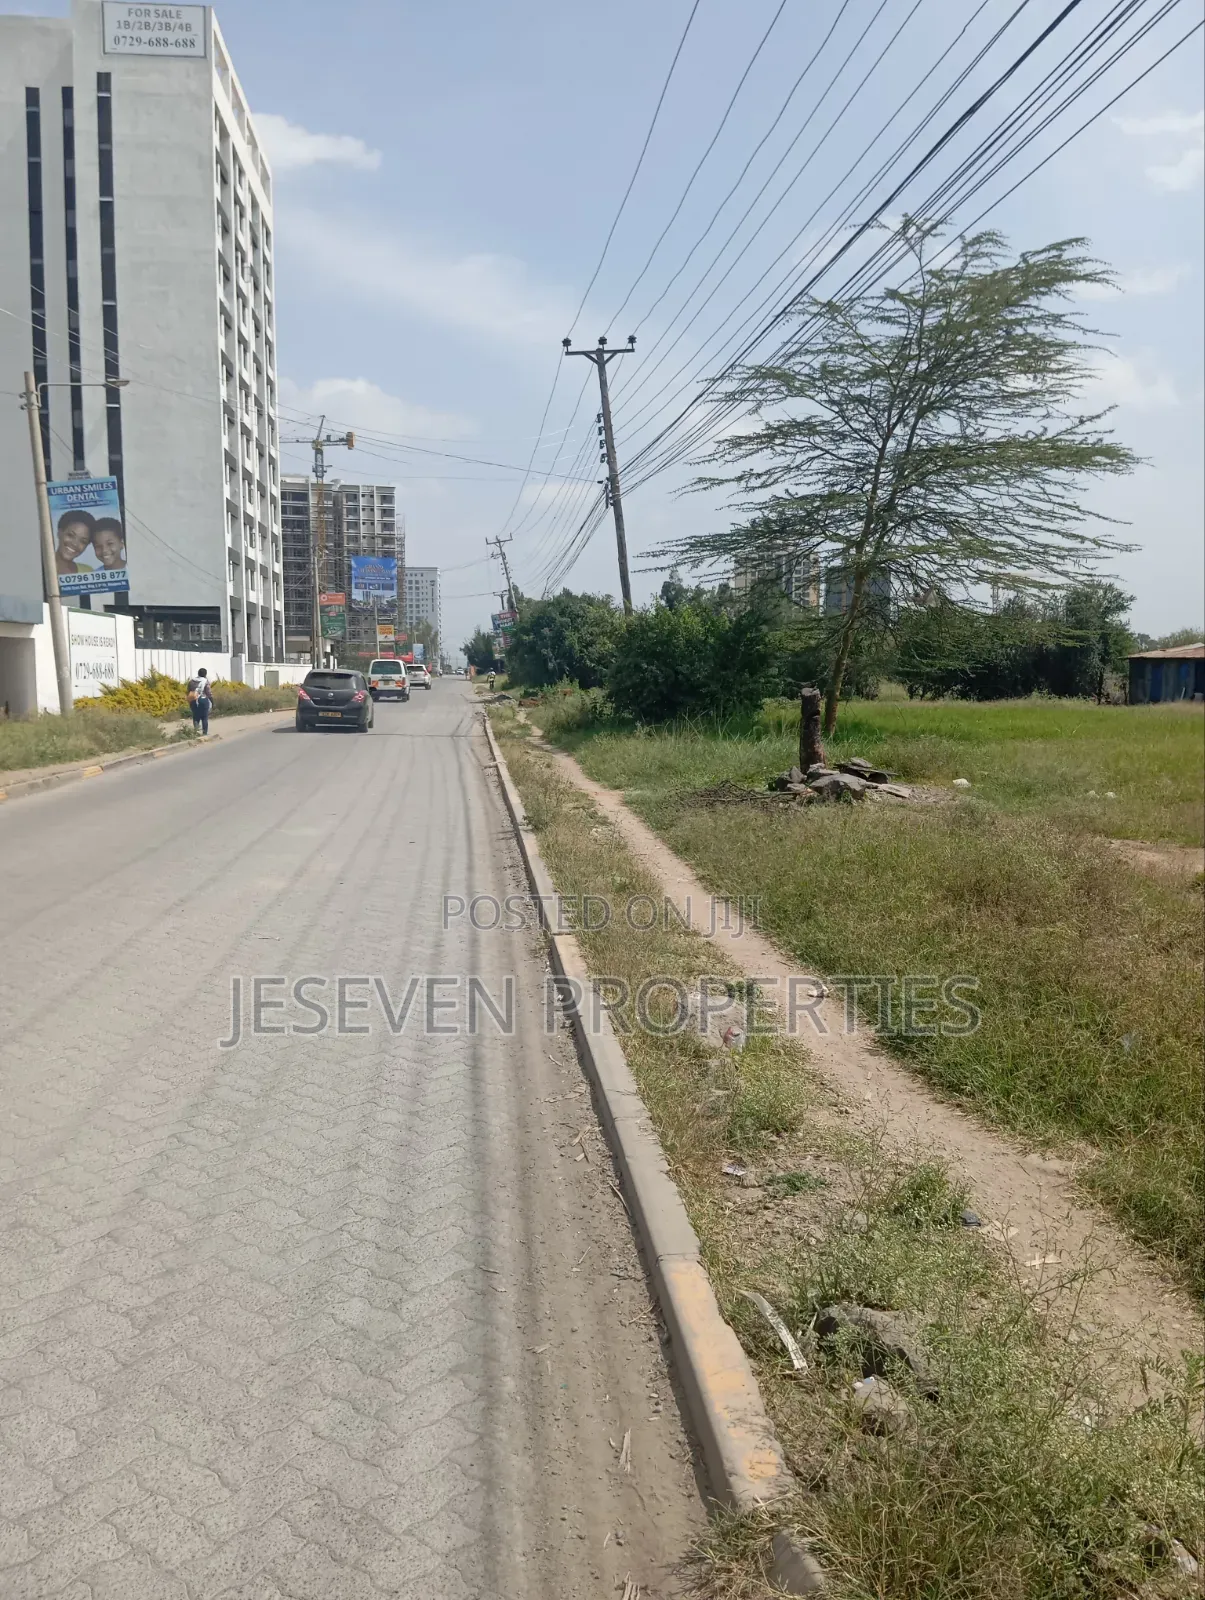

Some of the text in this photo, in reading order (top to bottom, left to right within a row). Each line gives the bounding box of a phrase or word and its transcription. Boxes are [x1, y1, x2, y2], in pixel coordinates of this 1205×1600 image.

[127, 8, 183, 19] FOR SALE
[115, 20, 193, 32] 1B/2B/3B/4B
[113, 35, 196, 49] 0729-688-688
[51, 482, 113, 496] URBAN SMILES
[67, 491, 100, 502] DENTAL
[65, 570, 127, 584] 0796 198 877
[71, 634, 85, 646] SHOW
[75, 662, 115, 680] 0729-688-688
